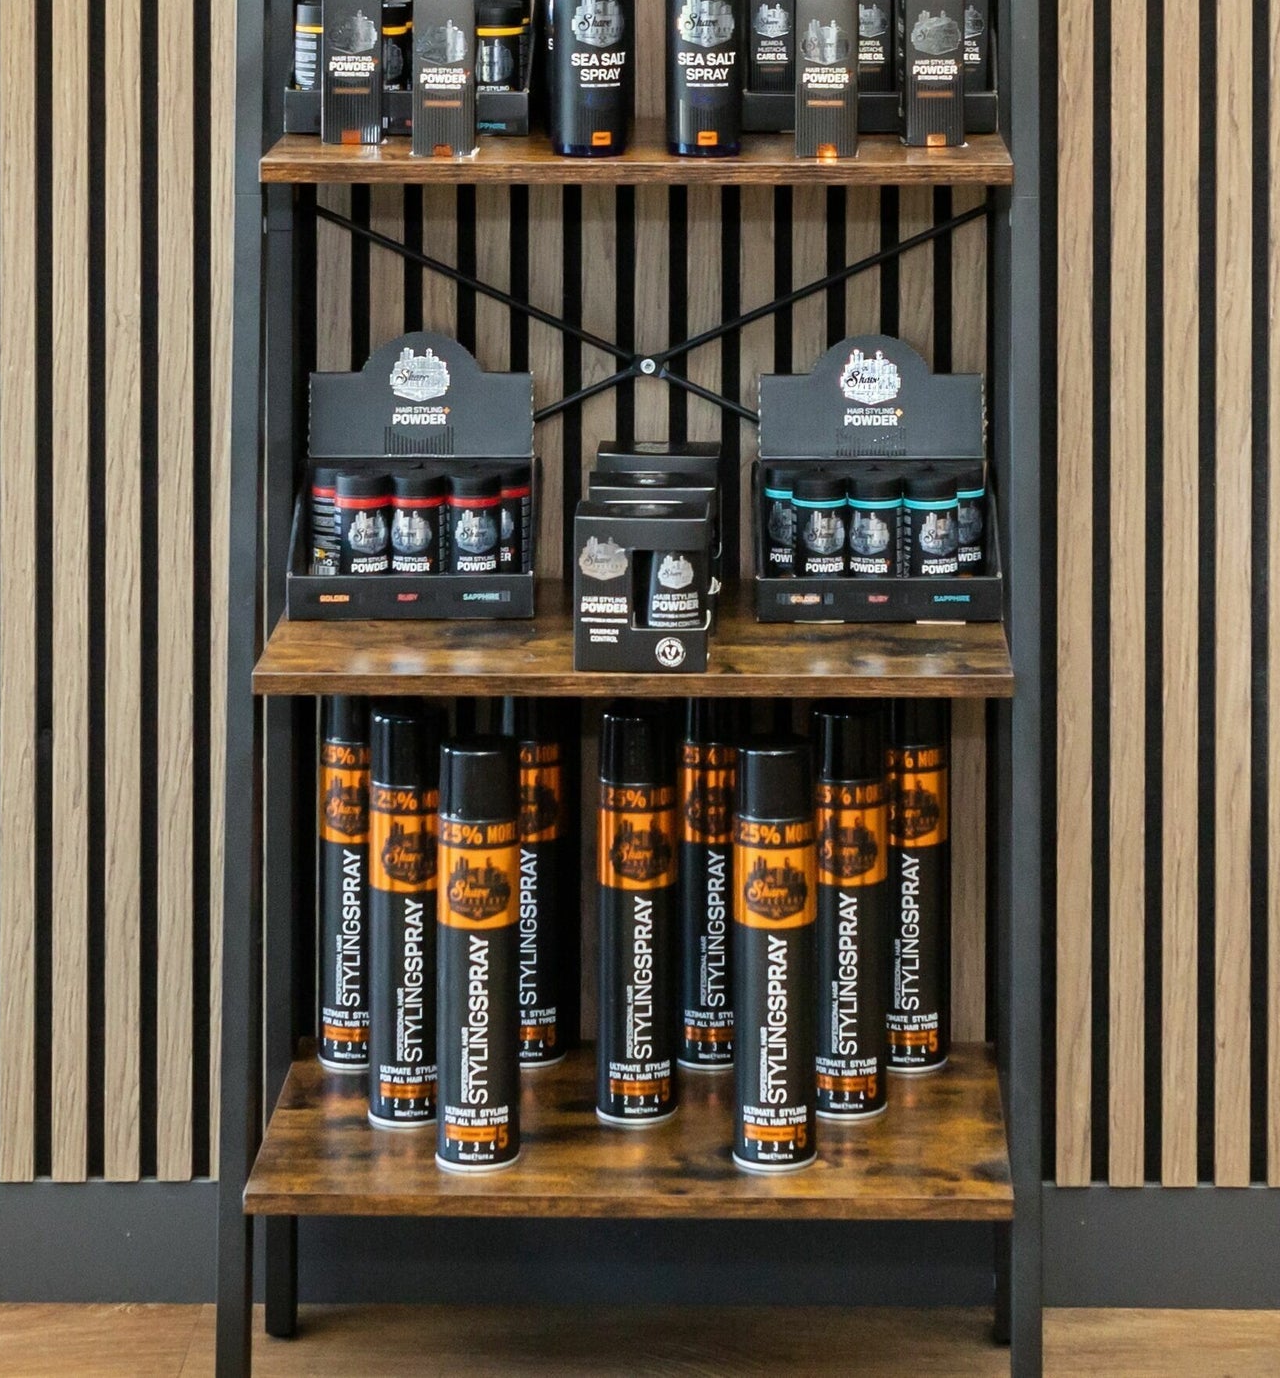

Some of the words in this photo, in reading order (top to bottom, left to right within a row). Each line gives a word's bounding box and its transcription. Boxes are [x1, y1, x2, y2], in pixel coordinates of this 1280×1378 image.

[571, 52, 599, 66] SEA
[601, 51, 626, 66] SALT
[677, 51, 704, 66] SEA
[706, 51, 736, 66] SALT
[329, 62, 375, 72] POWDER
[686, 67, 729, 80] SPRAY
[912, 65, 958, 75] POWDER
[420, 73, 466, 84] POWDER
[580, 68, 621, 81] SPRAY
[802, 73, 849, 83] POWDER
[392, 414, 446, 425] POWDER
[844, 415, 898, 426] POWDER
[351, 560, 388, 573] POWDER
[392, 560, 430, 572] POWDER
[457, 560, 496, 571] POWDER
[805, 562, 844, 573] POWDER
[849, 561, 887, 573] POWDER
[921, 562, 958, 574] POWDER
[397, 593, 418, 601] RUBY
[463, 592, 500, 601] SAPPHIRE
[581, 602, 628, 613] POWDER
[652, 599, 699, 611] POWDER
[377, 790, 418, 811] 25%
[443, 822, 483, 845] 25%
[740, 823, 780, 845] 25%
[450, 879, 491, 901] Shave
[342, 849, 361, 1007] STYLINGSPRAY
[520, 849, 538, 1005] STYLINGSPRAY
[707, 850, 725, 1007] STYLINGSPRAY
[901, 853, 920, 1010] STYLINGSPRAY
[404, 898, 423, 1062] STYLINGSPRAY
[634, 895, 653, 1060] STYLINGSPRAY
[839, 892, 858, 1055] STYLINGSPRAY
[469, 934, 489, 1105] STYLINGSPRAY
[767, 934, 787, 1104] STYLINGSPRAY
[928, 1030, 938, 1053] 5
[458, 1140, 463, 1151] 2
[474, 1141, 479, 1152] 3
[489, 1140, 495, 1150] 4
[498, 1124, 508, 1149] 5
[757, 1140, 762, 1151] 2
[773, 1140, 778, 1152] 3
